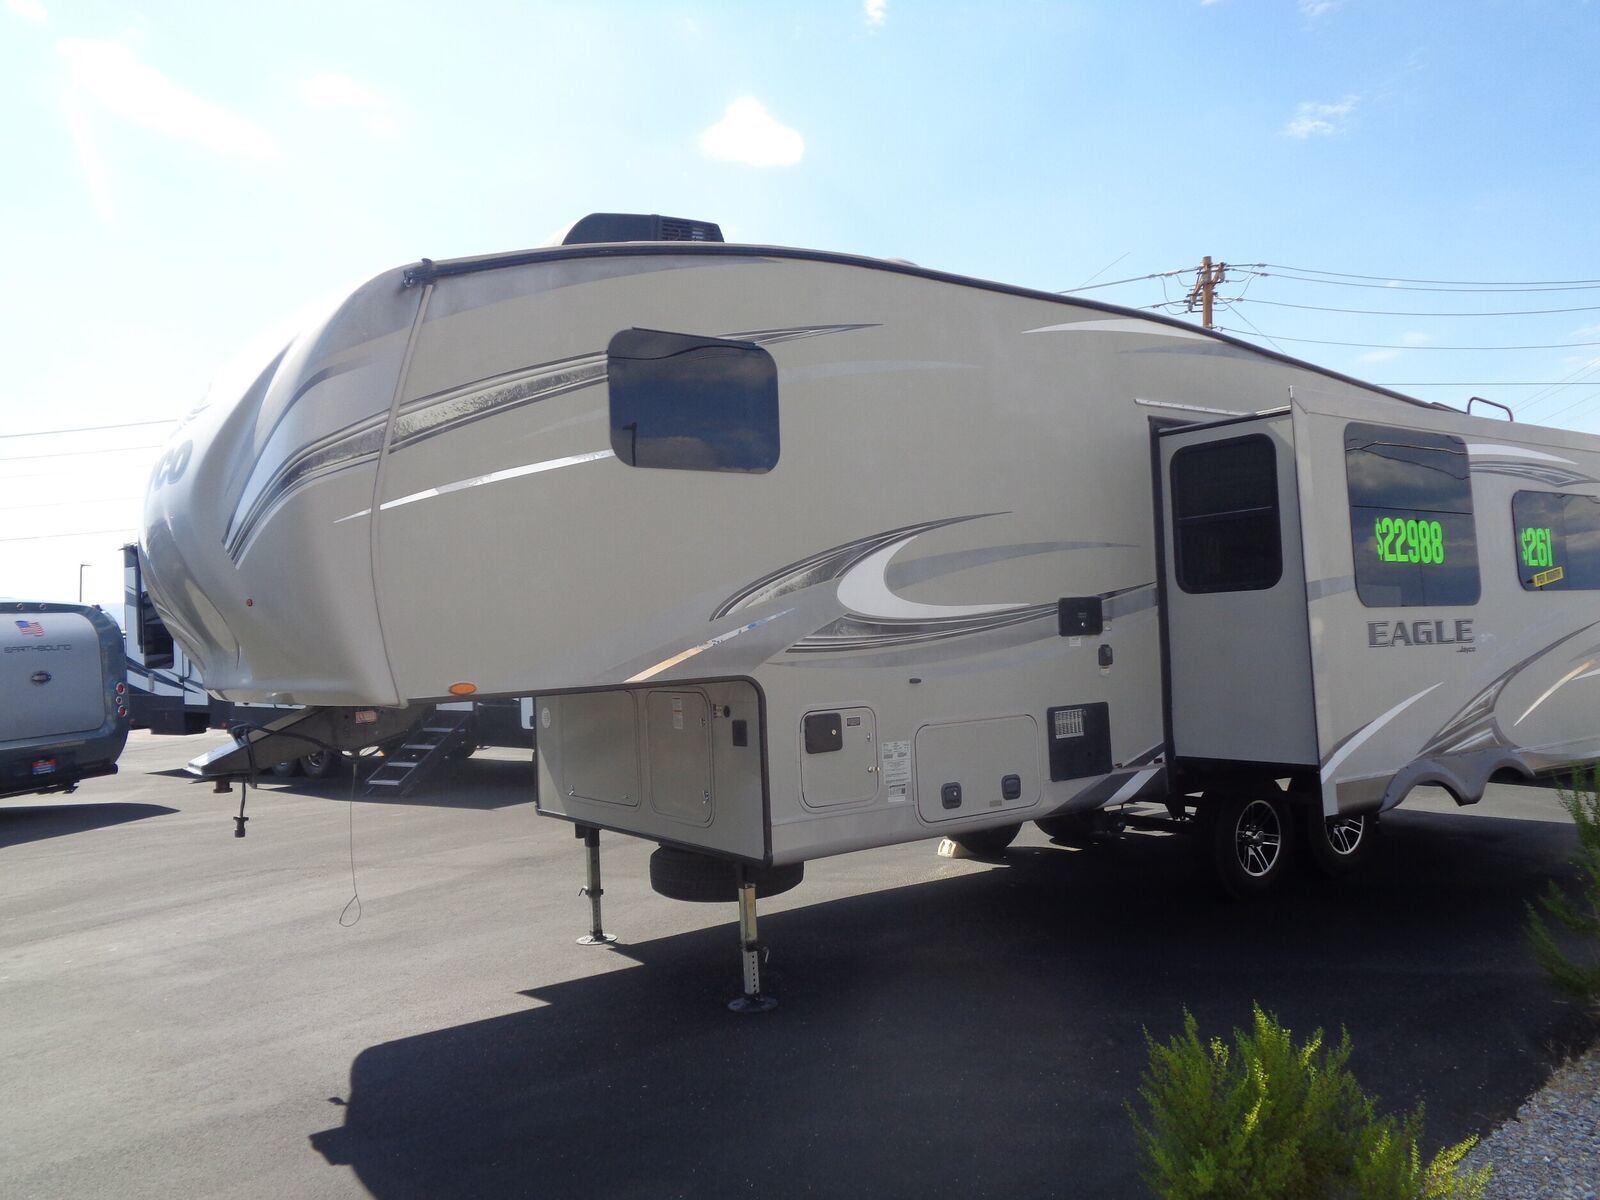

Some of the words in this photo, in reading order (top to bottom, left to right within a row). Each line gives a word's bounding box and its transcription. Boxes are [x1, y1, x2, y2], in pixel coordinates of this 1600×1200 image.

[1375, 517, 1444, 564] $22988
[1521, 527, 1553, 567] $261
[1367, 619, 1475, 648] EAGLE
